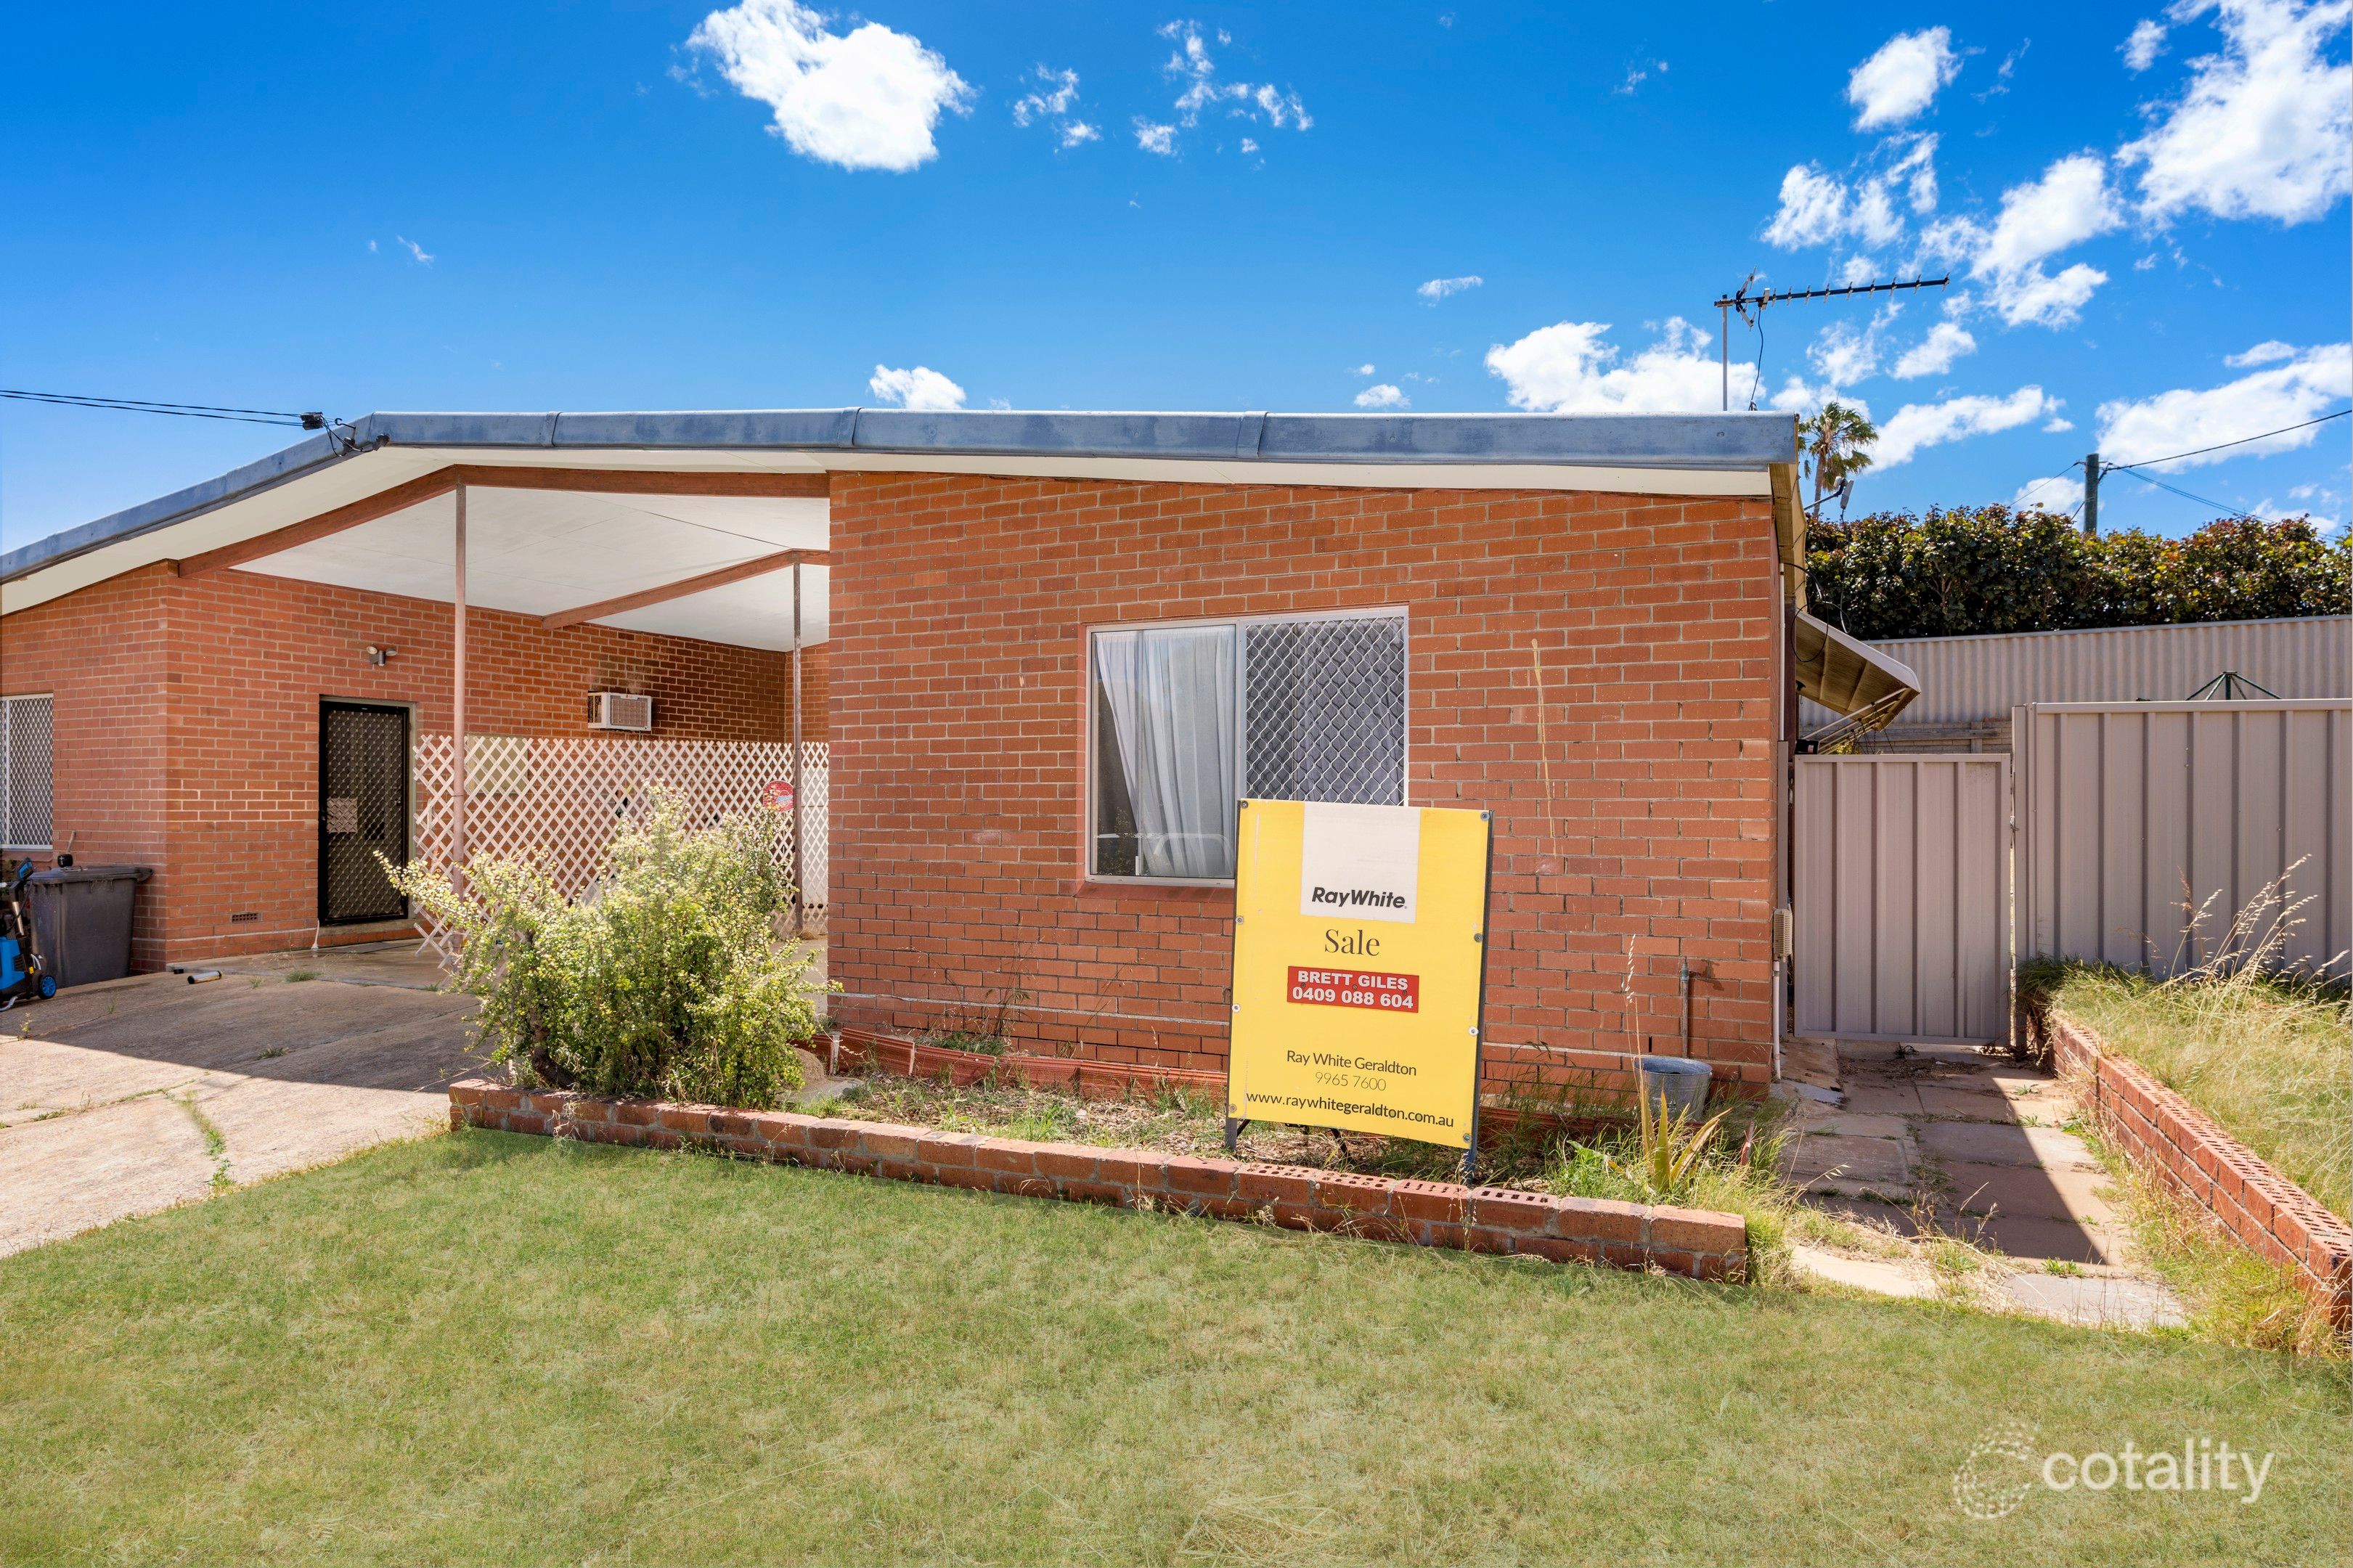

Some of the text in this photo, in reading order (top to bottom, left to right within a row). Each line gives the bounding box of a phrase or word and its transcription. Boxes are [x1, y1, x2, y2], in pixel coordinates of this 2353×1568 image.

[1311, 886, 1406, 908] RayWhite
[1324, 928, 1380, 956] Sale
[1297, 971, 1408, 990] BRETT GILES
[1292, 987, 1414, 1008] 0409 088 604
[1286, 1050, 1417, 1076] Ray White Geraldton
[1315, 1071, 1387, 1091] 9965 7600
[1246, 1093, 1454, 1127] www.raywhitegeraldton.com.au
